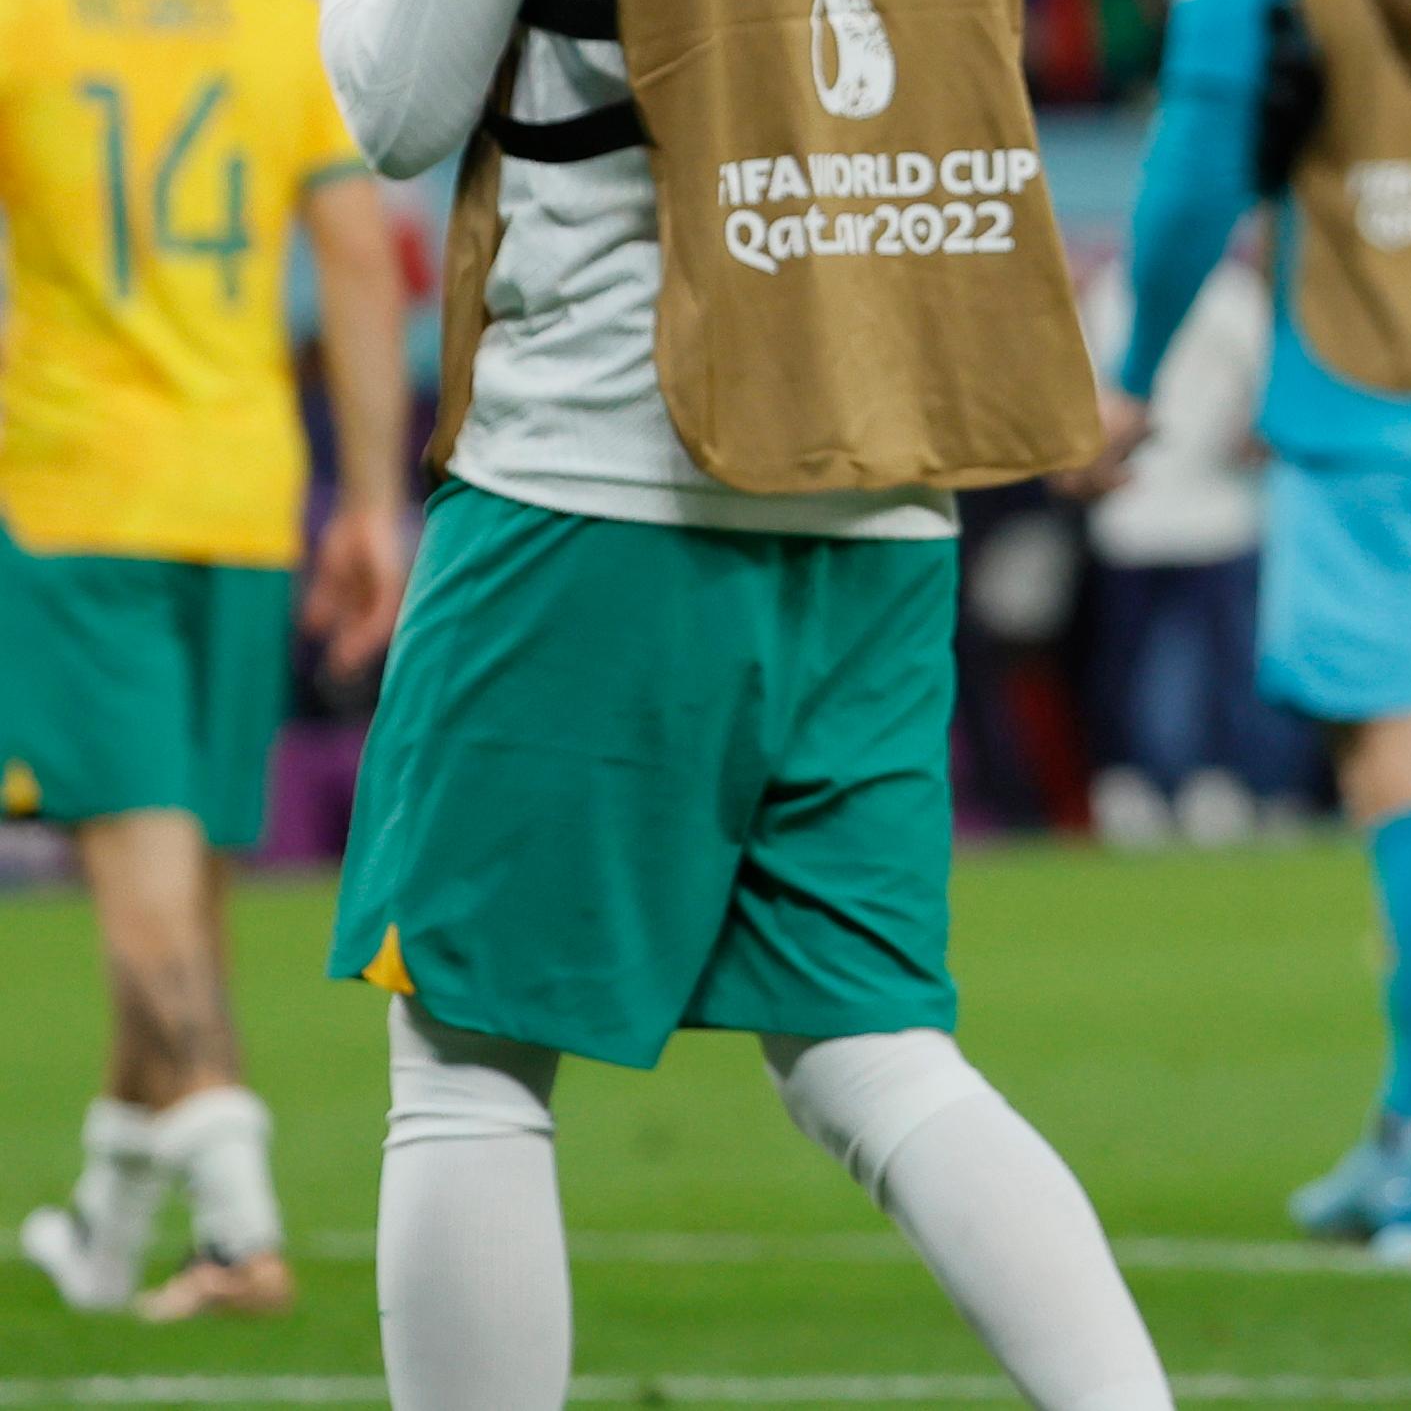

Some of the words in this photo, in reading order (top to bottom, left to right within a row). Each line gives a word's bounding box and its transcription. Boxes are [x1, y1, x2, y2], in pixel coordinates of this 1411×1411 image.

[74, 76, 254, 301] 14
[807, 151, 937, 199] WORLD
[940, 148, 1041, 196] CUP
[724, 199, 1016, 276] Qatar2022
